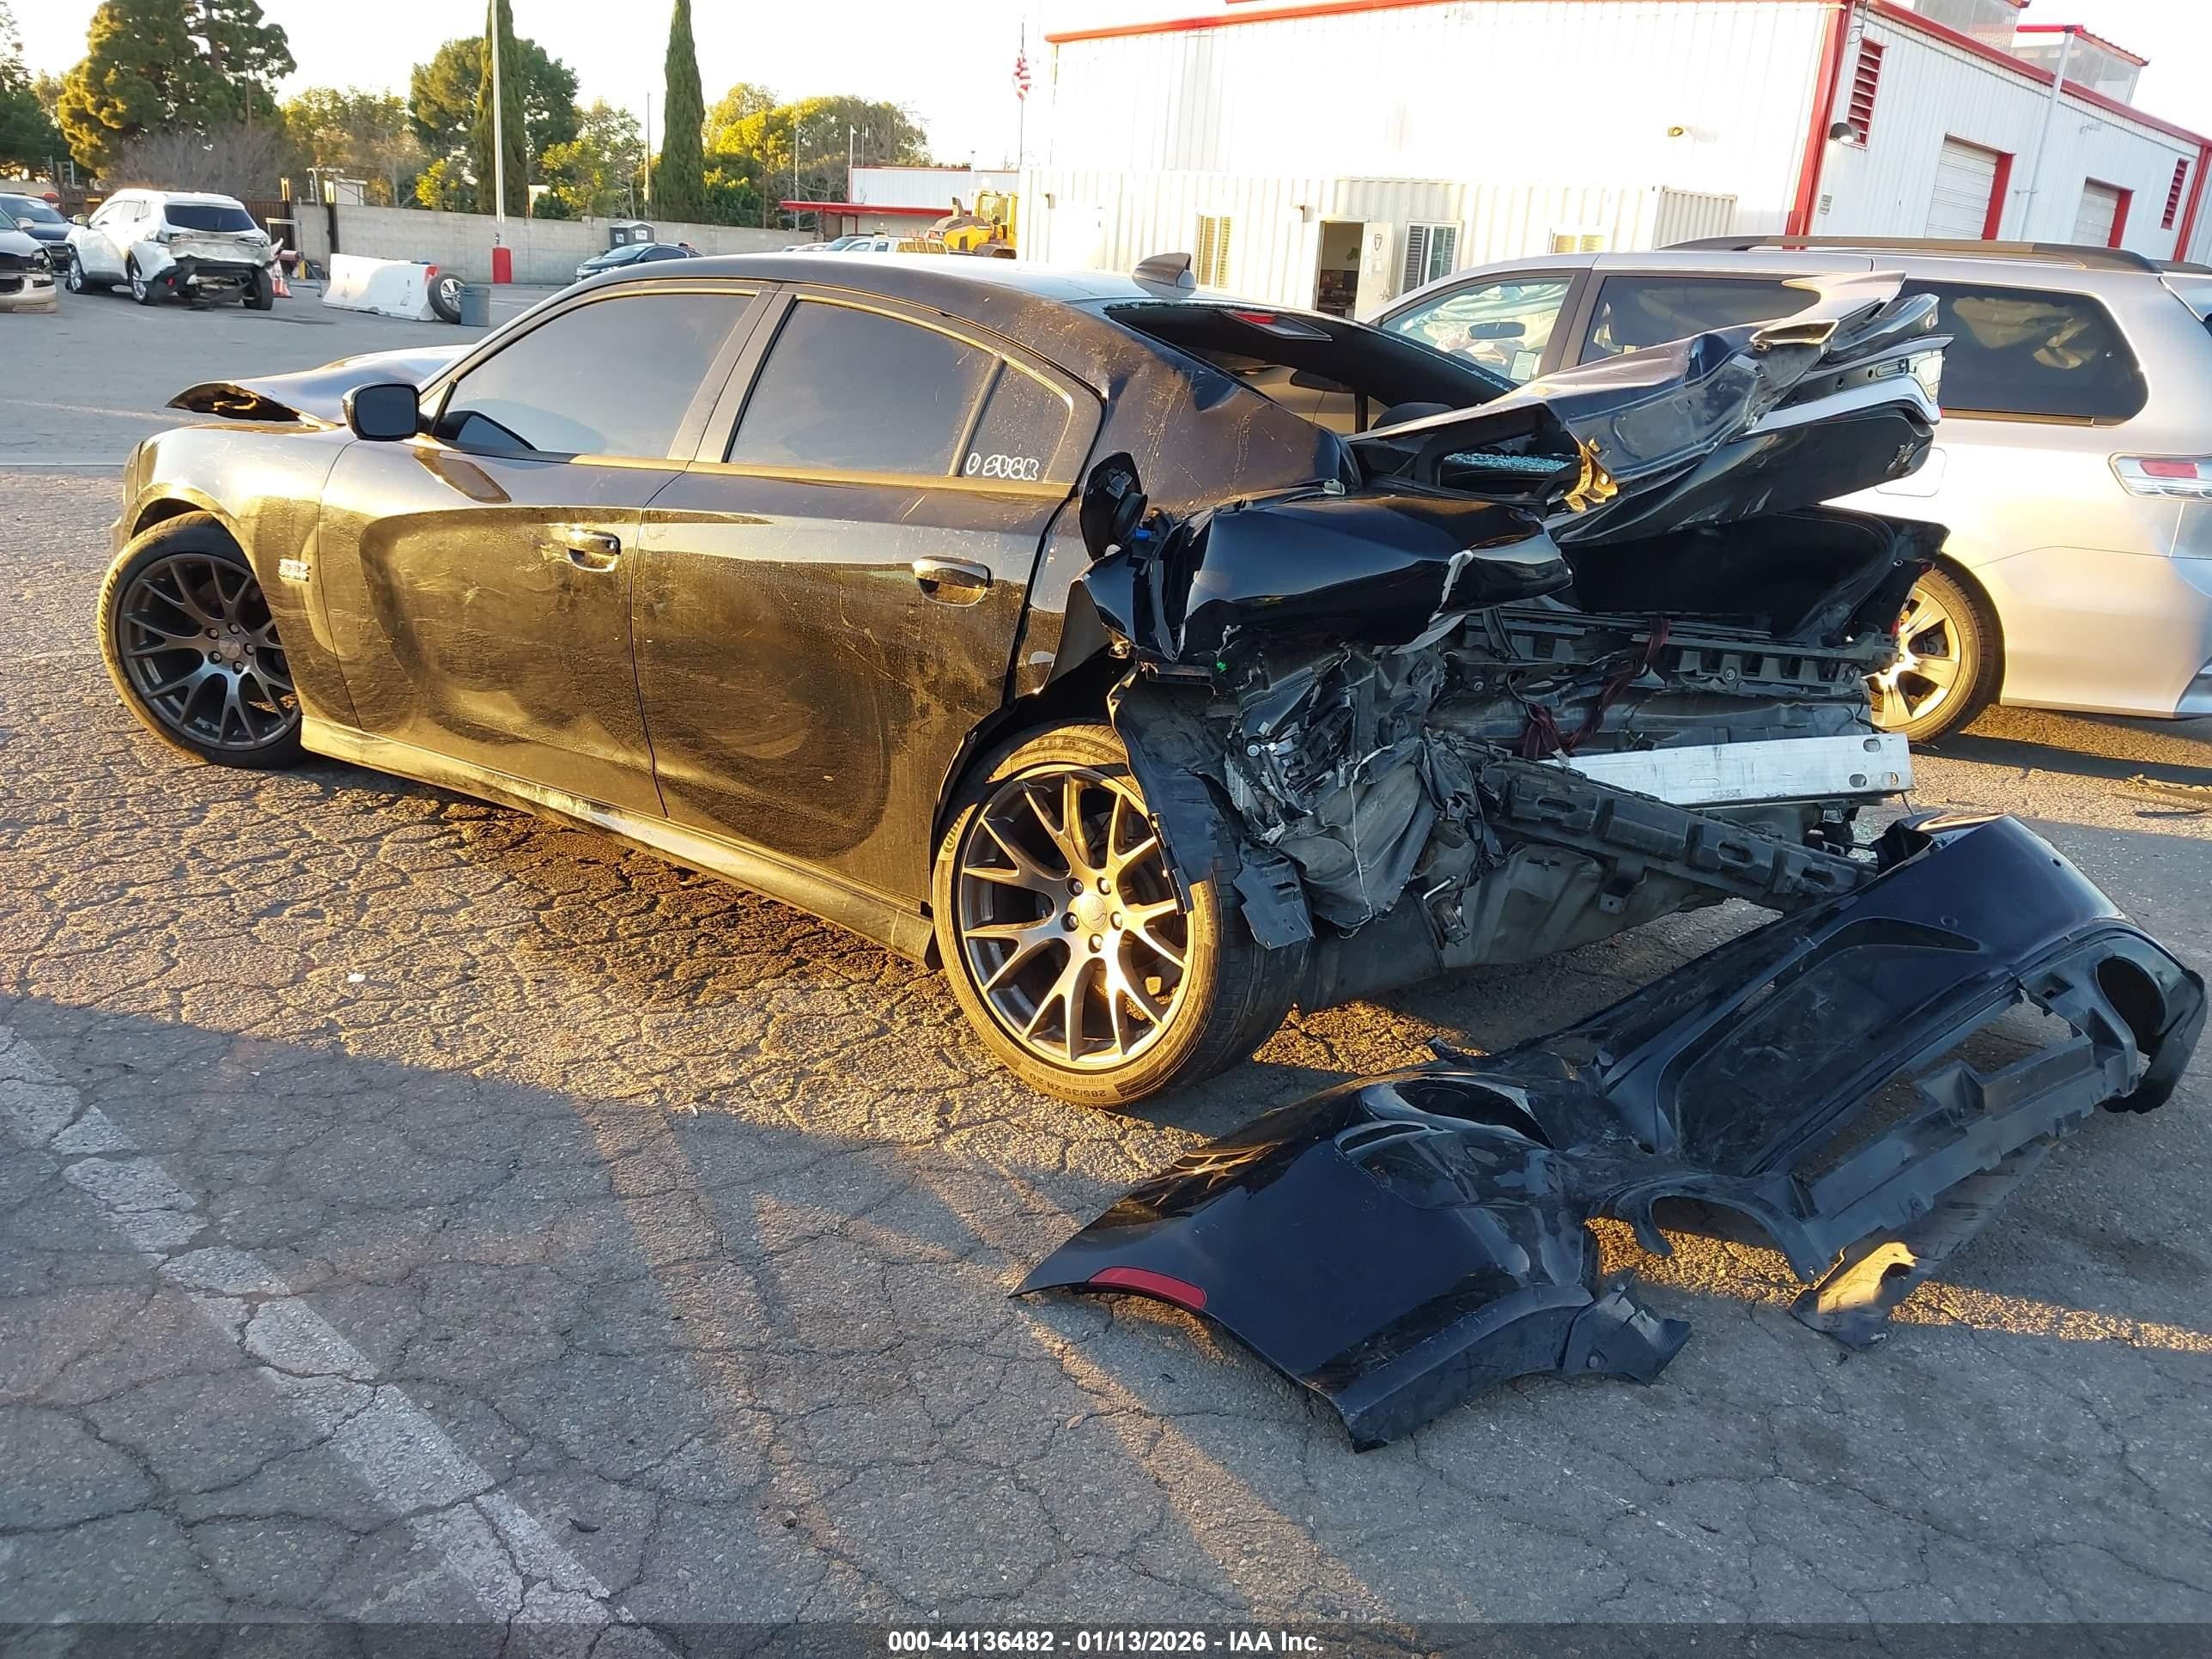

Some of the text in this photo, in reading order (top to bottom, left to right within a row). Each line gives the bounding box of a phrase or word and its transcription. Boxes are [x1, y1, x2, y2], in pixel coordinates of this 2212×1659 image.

[1029, 1073, 1044, 1085] 20
[1047, 1081, 1061, 1092] ZR
[1064, 1087, 1106, 1097] 285/35
